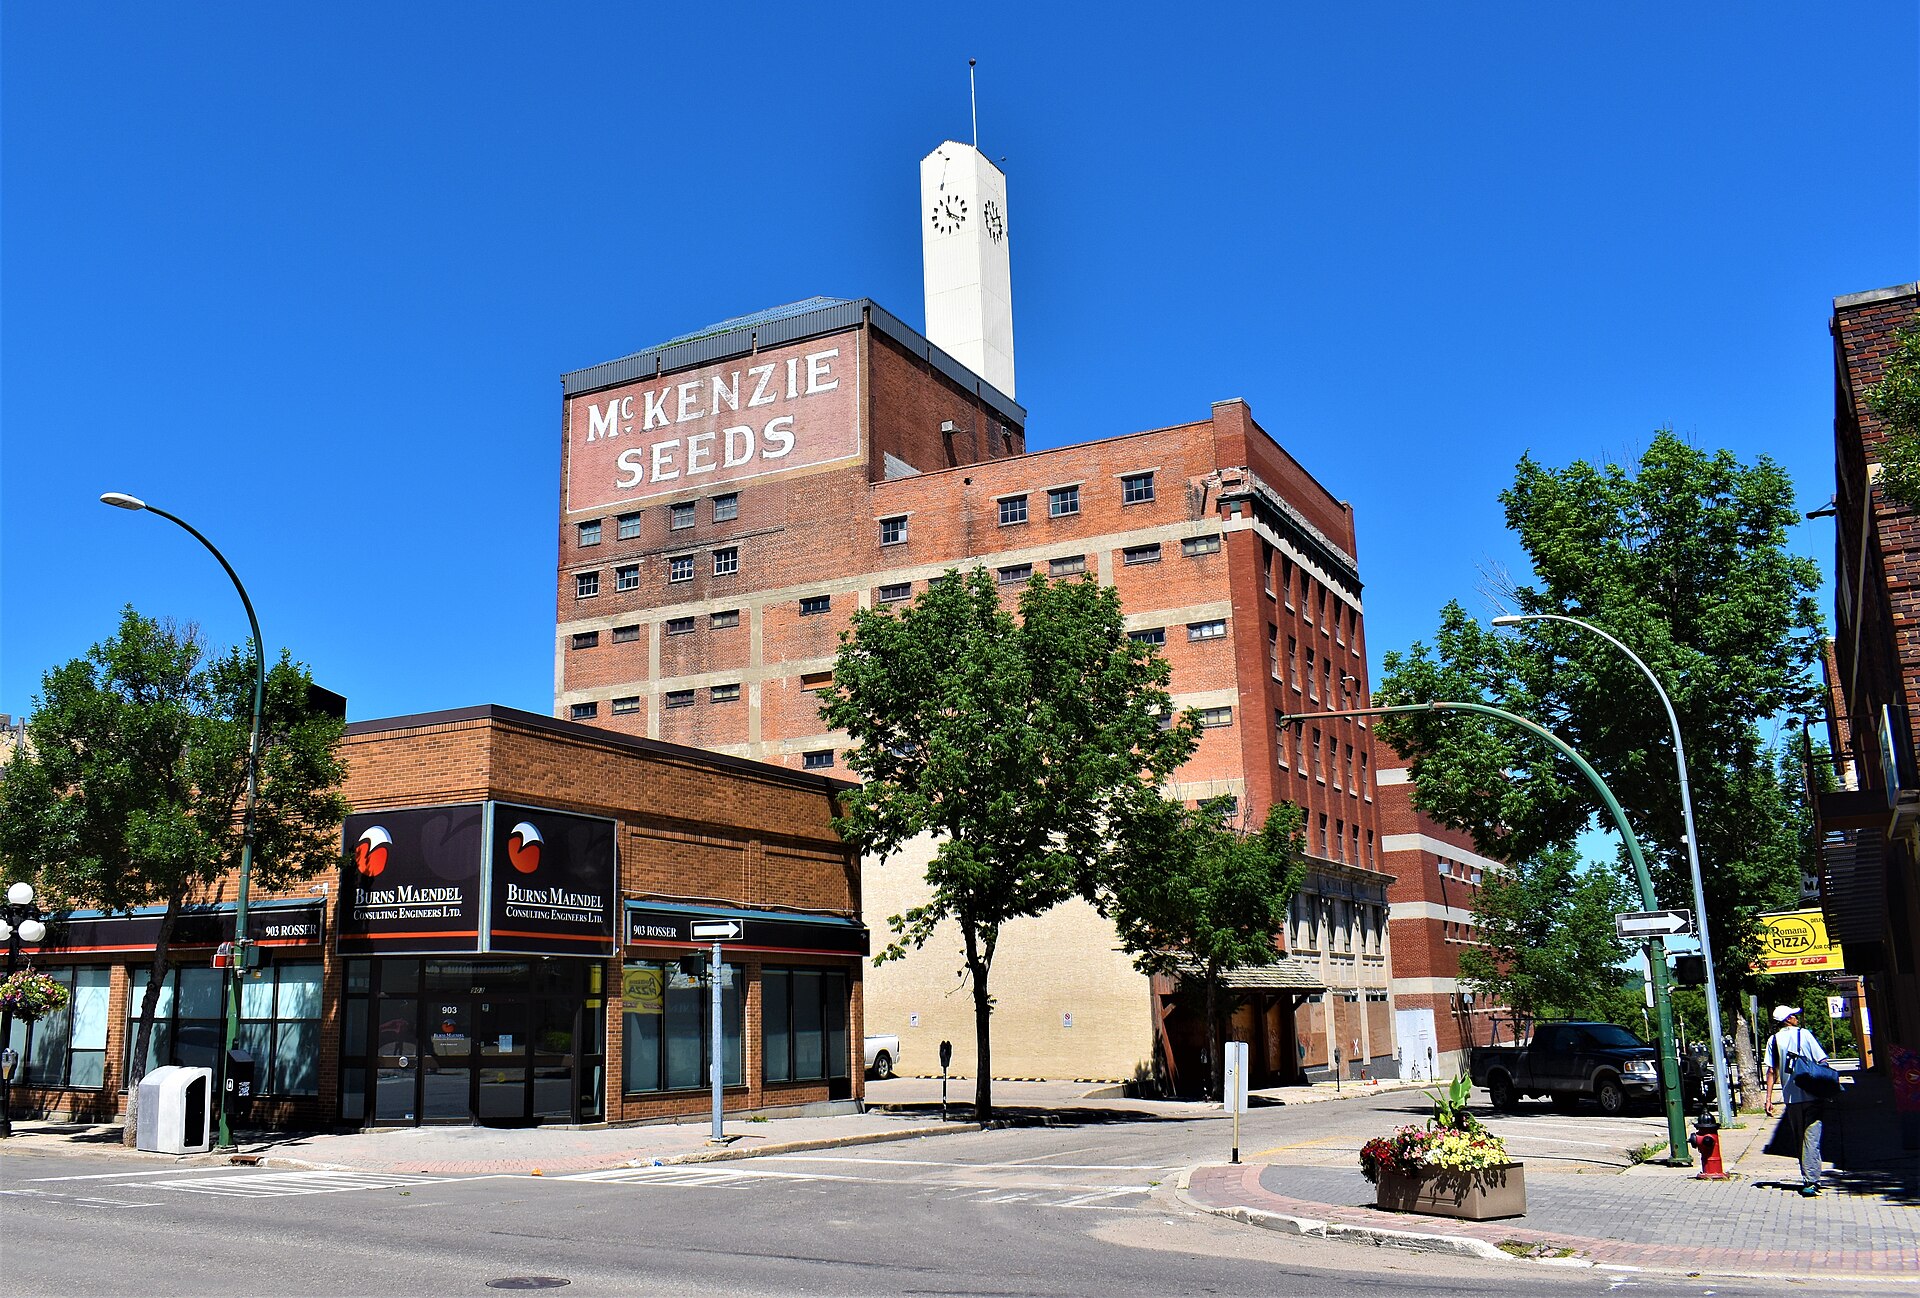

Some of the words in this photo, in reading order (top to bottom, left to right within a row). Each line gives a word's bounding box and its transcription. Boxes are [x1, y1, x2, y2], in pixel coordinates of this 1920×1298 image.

[616, 413, 797, 489] SEEDS
[355, 888, 395, 904] BURNS
[397, 885, 463, 903] MAENDEL
[507, 883, 548, 904] BURNS
[549, 887, 603, 908] MAENDEL
[353, 909, 398, 920] CONSULTING
[398, 907, 441, 919] ENGINEERS
[442, 906, 462, 917] LTD.
[505, 906, 550, 920] CONSULTING
[550, 909, 588, 922] ENGINEERS
[588, 912, 603, 923] LTD.
[265, 925, 279, 937] 903
[280, 924, 317, 936] ROSSER
[633, 924, 646, 936] 903
[646, 925, 677, 938] ROSSER
[1771, 926, 1807, 937] Romana
[1773, 936, 1810, 948] PIZZA
[441, 1006, 457, 1014] 903
